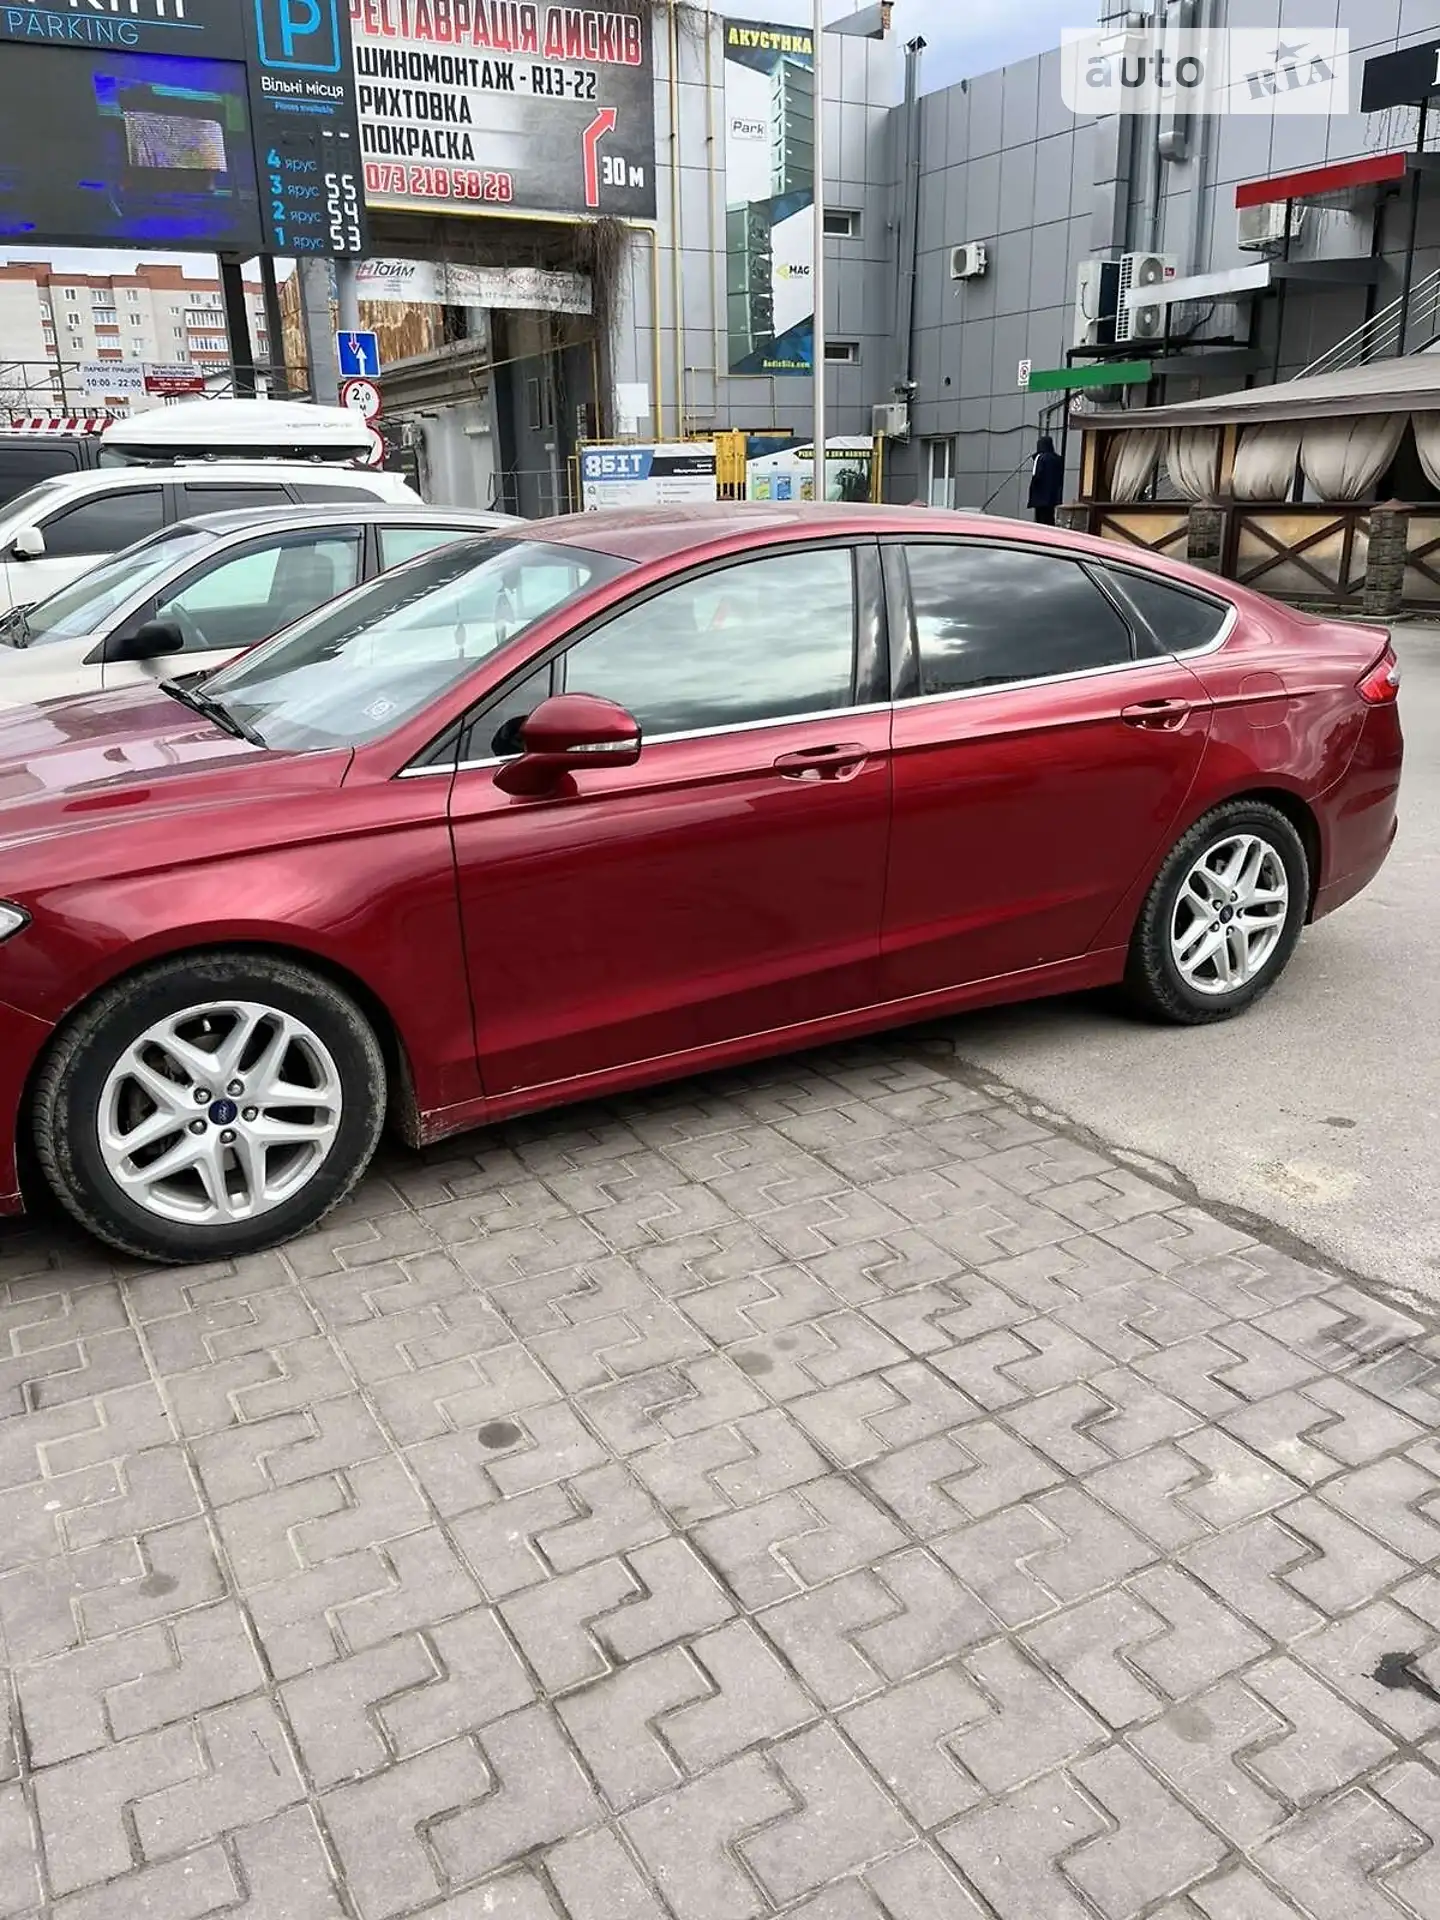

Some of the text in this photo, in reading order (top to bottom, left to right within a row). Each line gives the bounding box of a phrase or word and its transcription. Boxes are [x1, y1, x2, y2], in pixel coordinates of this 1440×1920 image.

[7, 10, 139, 45] PARKING
[543, 7, 642, 65] ДИСКІВ
[728, 27, 813, 54] АКУСТИКА
[261, 76, 344, 98] Вільні місця
[356, 47, 515, 91] ШИНОМОНТАЖ
[531, 66, 597, 100] R13-22
[359, 85, 472, 124] РИХТОВКА
[733, 120, 764, 134] Park
[361, 124, 475, 161] ПОКРАСКА
[267, 148, 317, 174] 4 ярус
[602, 156, 626, 187] 30
[269, 173, 357, 200] 3 ярус 55
[364, 163, 513, 203] 073 218 58 28
[272, 199, 359, 225] 2 ярус 54
[274, 225, 361, 251] 1 ярус 53
[789, 264, 810, 275] MAG
